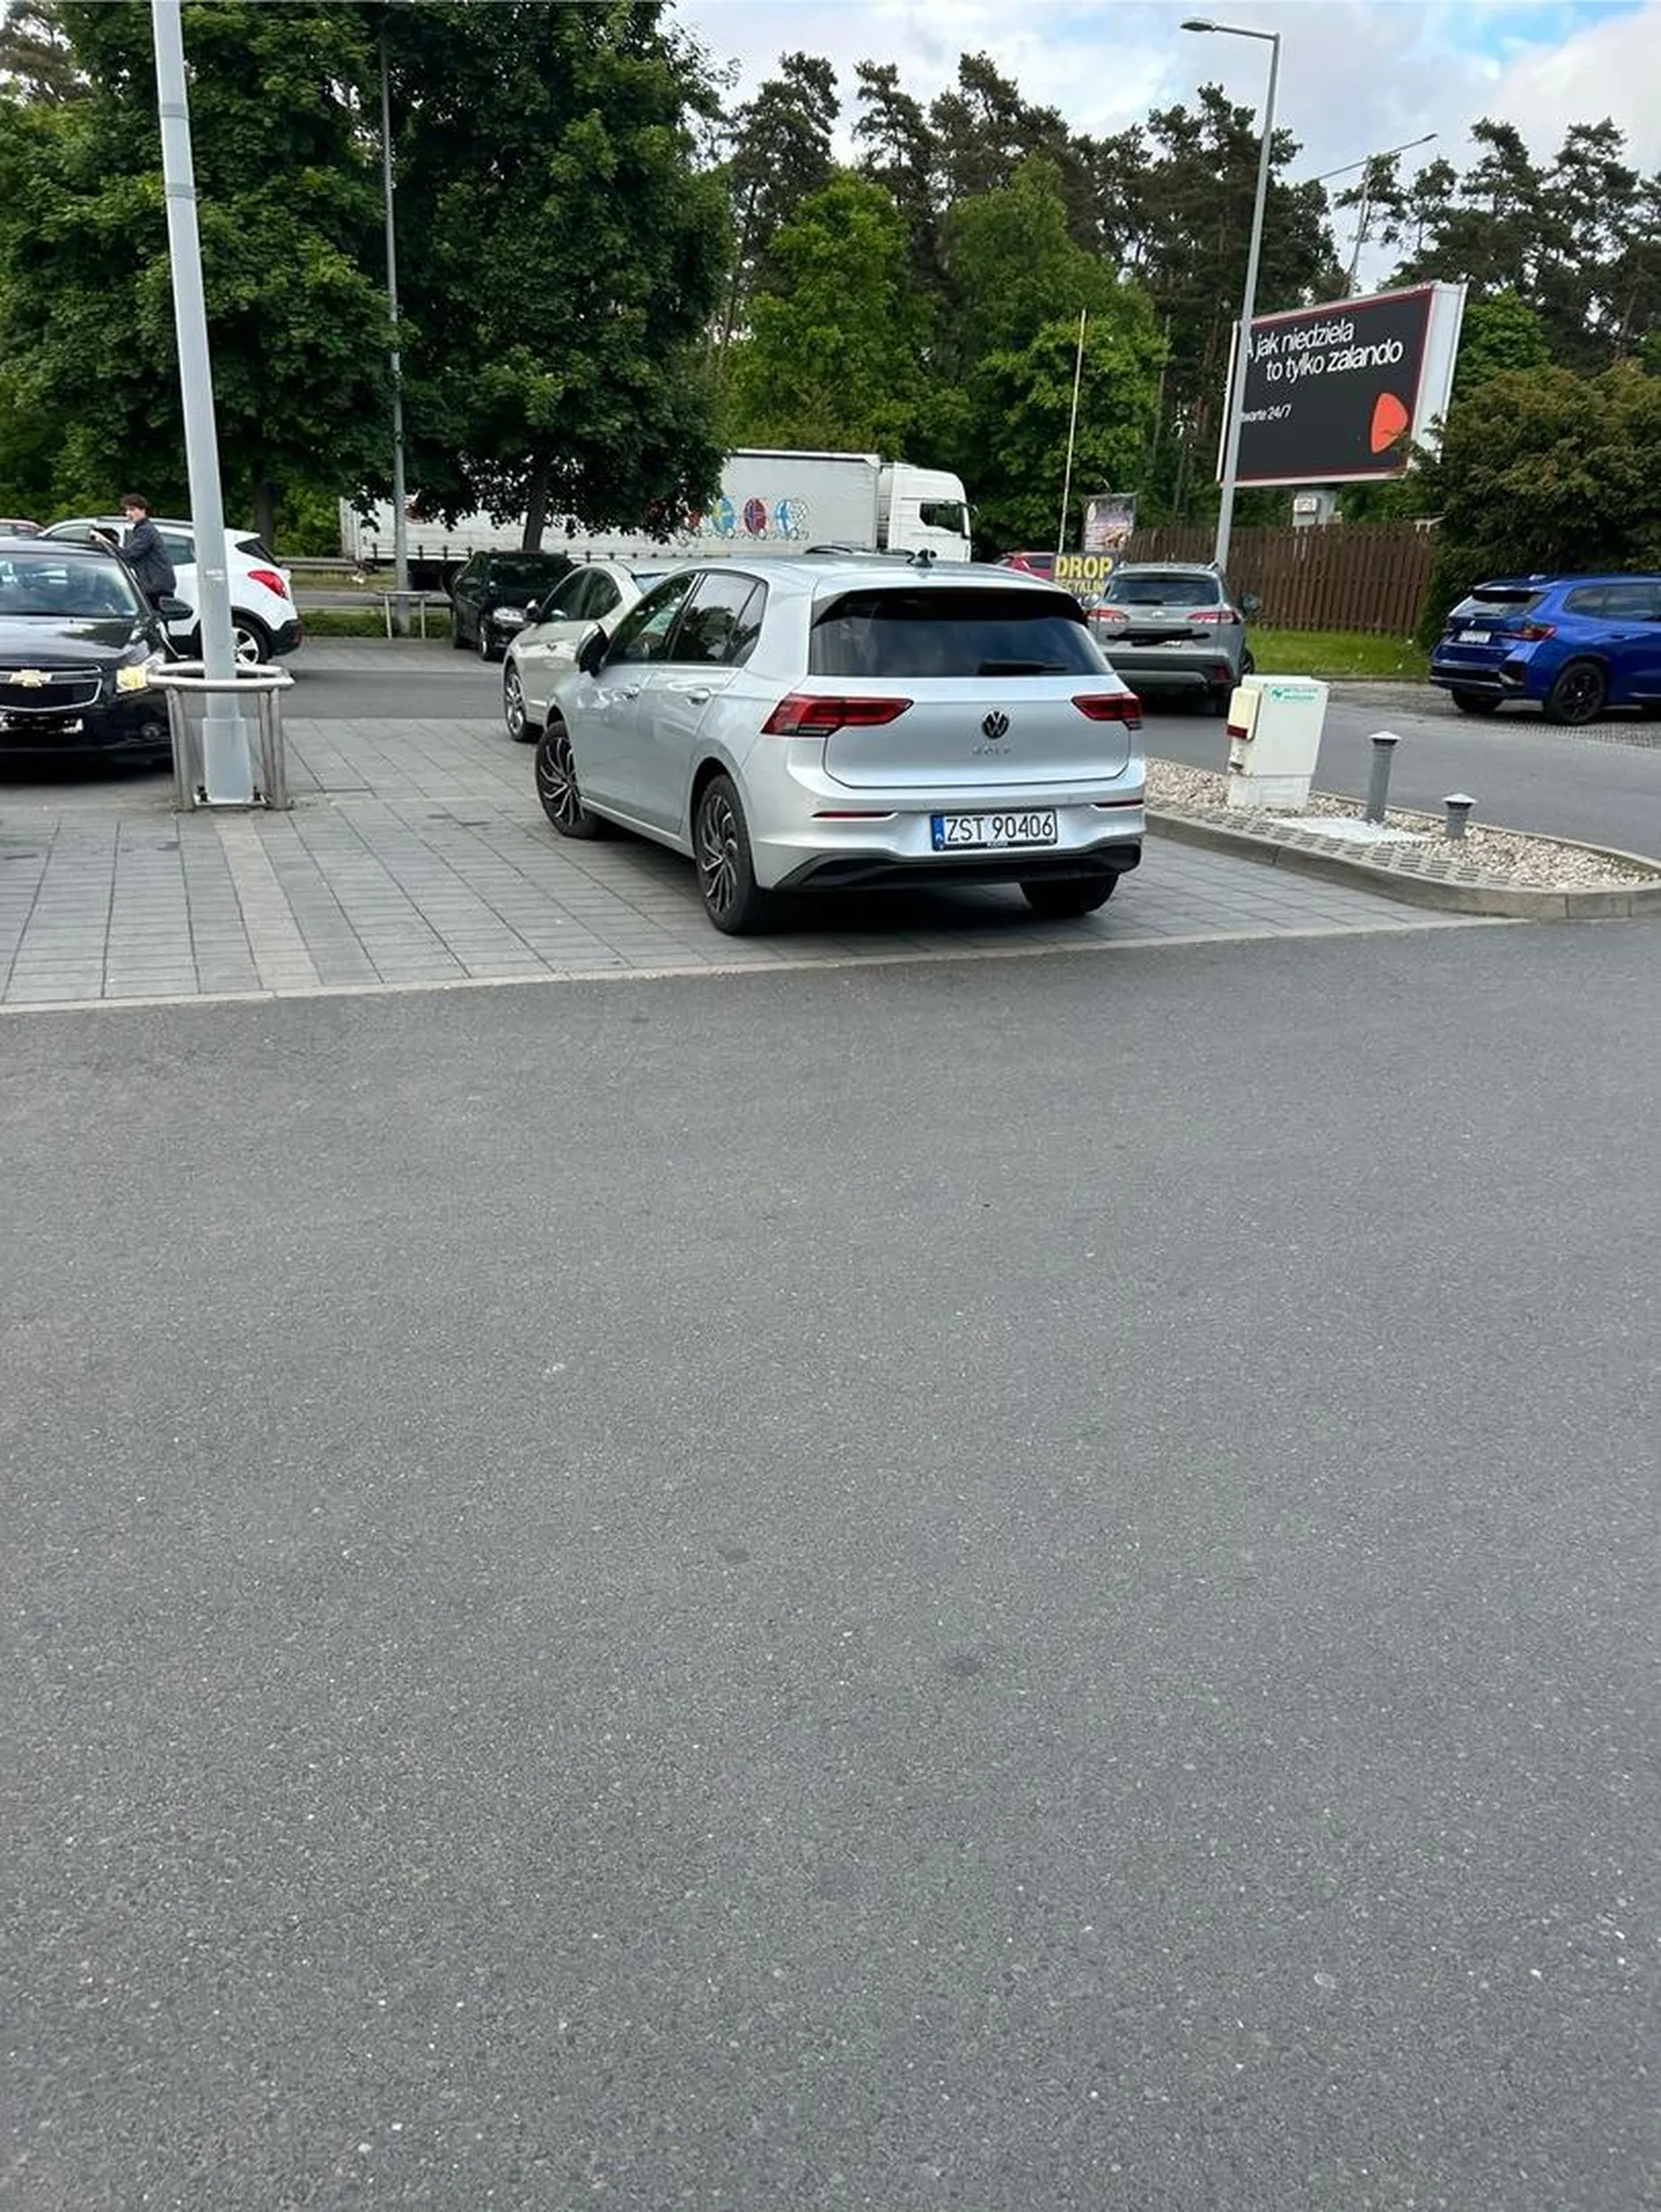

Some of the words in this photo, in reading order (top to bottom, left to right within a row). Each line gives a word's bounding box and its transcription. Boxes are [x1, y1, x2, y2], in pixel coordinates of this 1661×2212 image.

[1254, 331, 1280, 364] jak
[1280, 318, 1355, 352] niedziela
[1266, 359, 1283, 381] to
[1286, 351, 1326, 384] tylko
[1326, 338, 1403, 373] zalando
[1267, 403, 1292, 420] 24/7
[1055, 555, 1113, 580] DROP
[946, 816, 985, 842] ZST
[992, 813, 1054, 840] 90406
